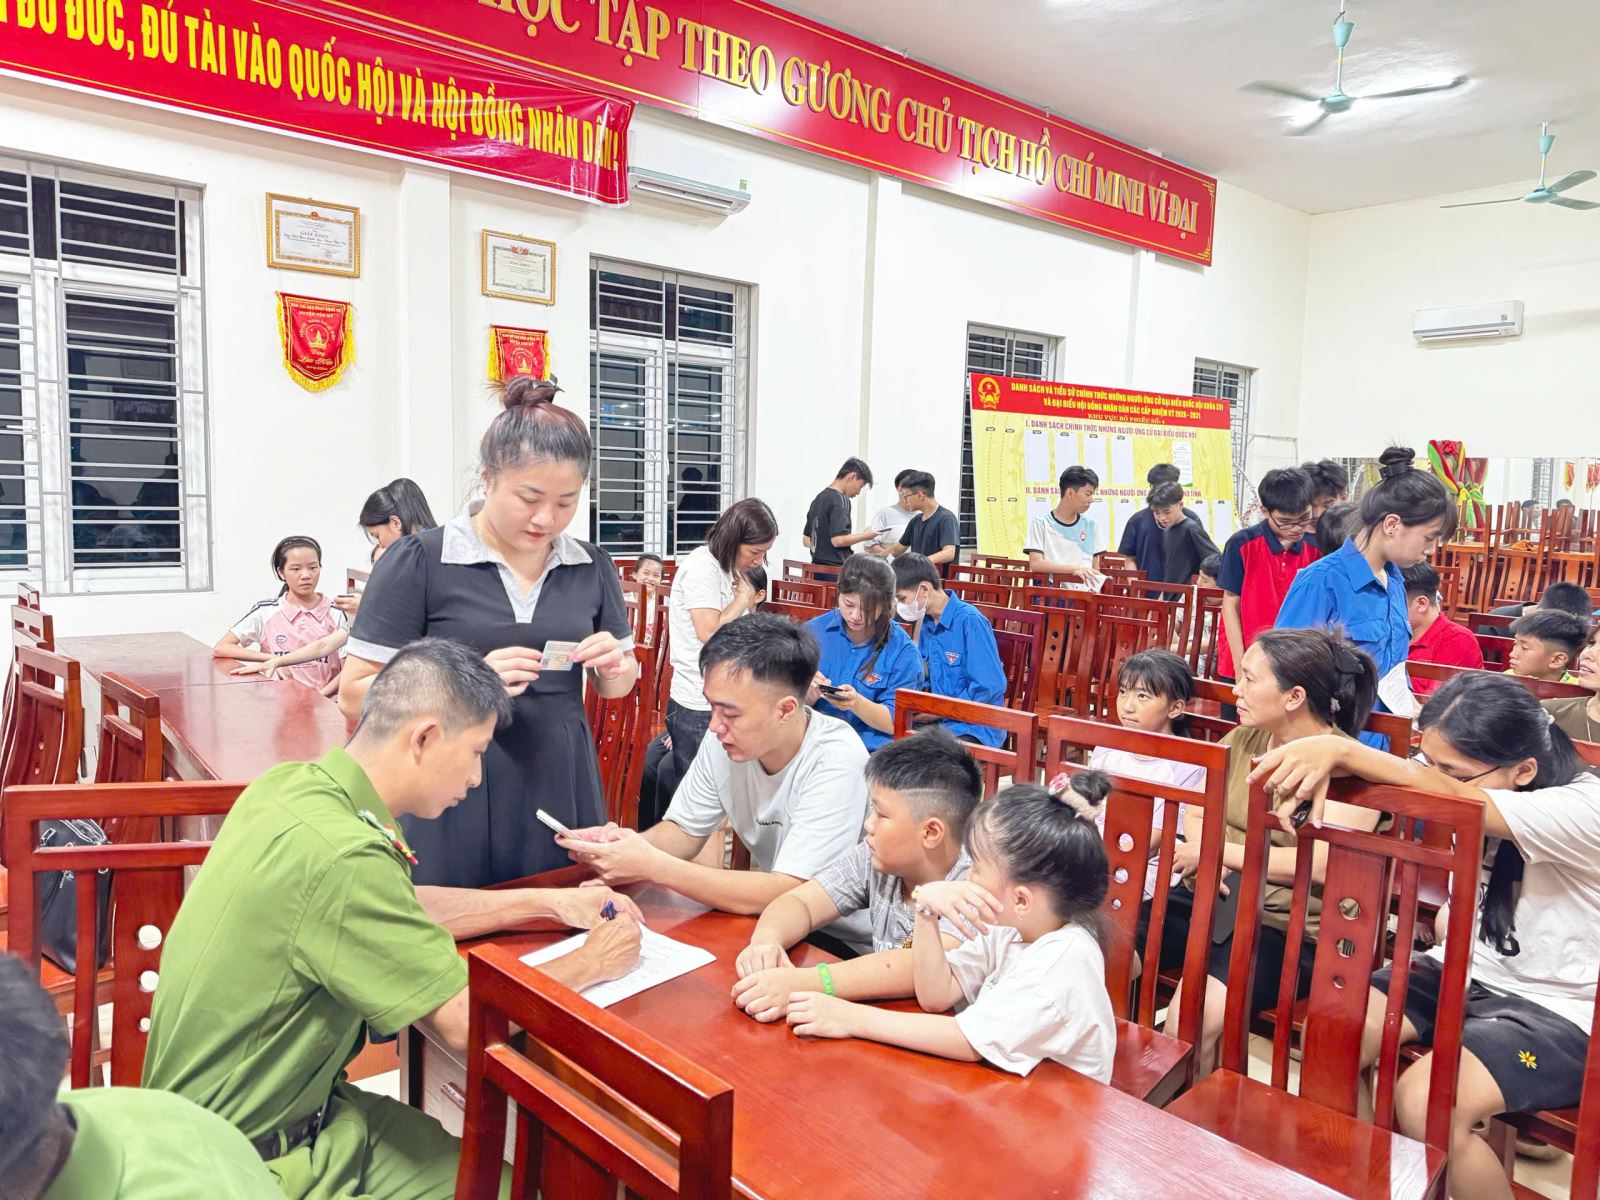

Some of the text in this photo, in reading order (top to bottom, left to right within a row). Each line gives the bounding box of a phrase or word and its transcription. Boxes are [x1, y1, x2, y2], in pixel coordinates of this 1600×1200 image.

[184, 8, 227, 77] TÀI
[232, 22, 283, 89] VÀO
[288, 36, 351, 106] QUỐC
[357, 57, 395, 125] HỘI
[399, 68, 427, 124] VÀ
[431, 79, 467, 141] HỘI
[470, 82, 524, 147] ĐỒNG
[528, 105, 578, 160] NHÂN
[677, 17, 777, 96] THEO
[781, 56, 891, 134] GƯƠNG
[896, 96, 954, 154] CHỦ
[957, 116, 1016, 176] TỊCH
[1016, 127, 1053, 186] HỒ
[1054, 152, 1094, 201] CHÍ
[1094, 166, 1146, 217] MINH
[1147, 180, 1169, 224] VĨ
[1168, 196, 1200, 240] ĐẠI
